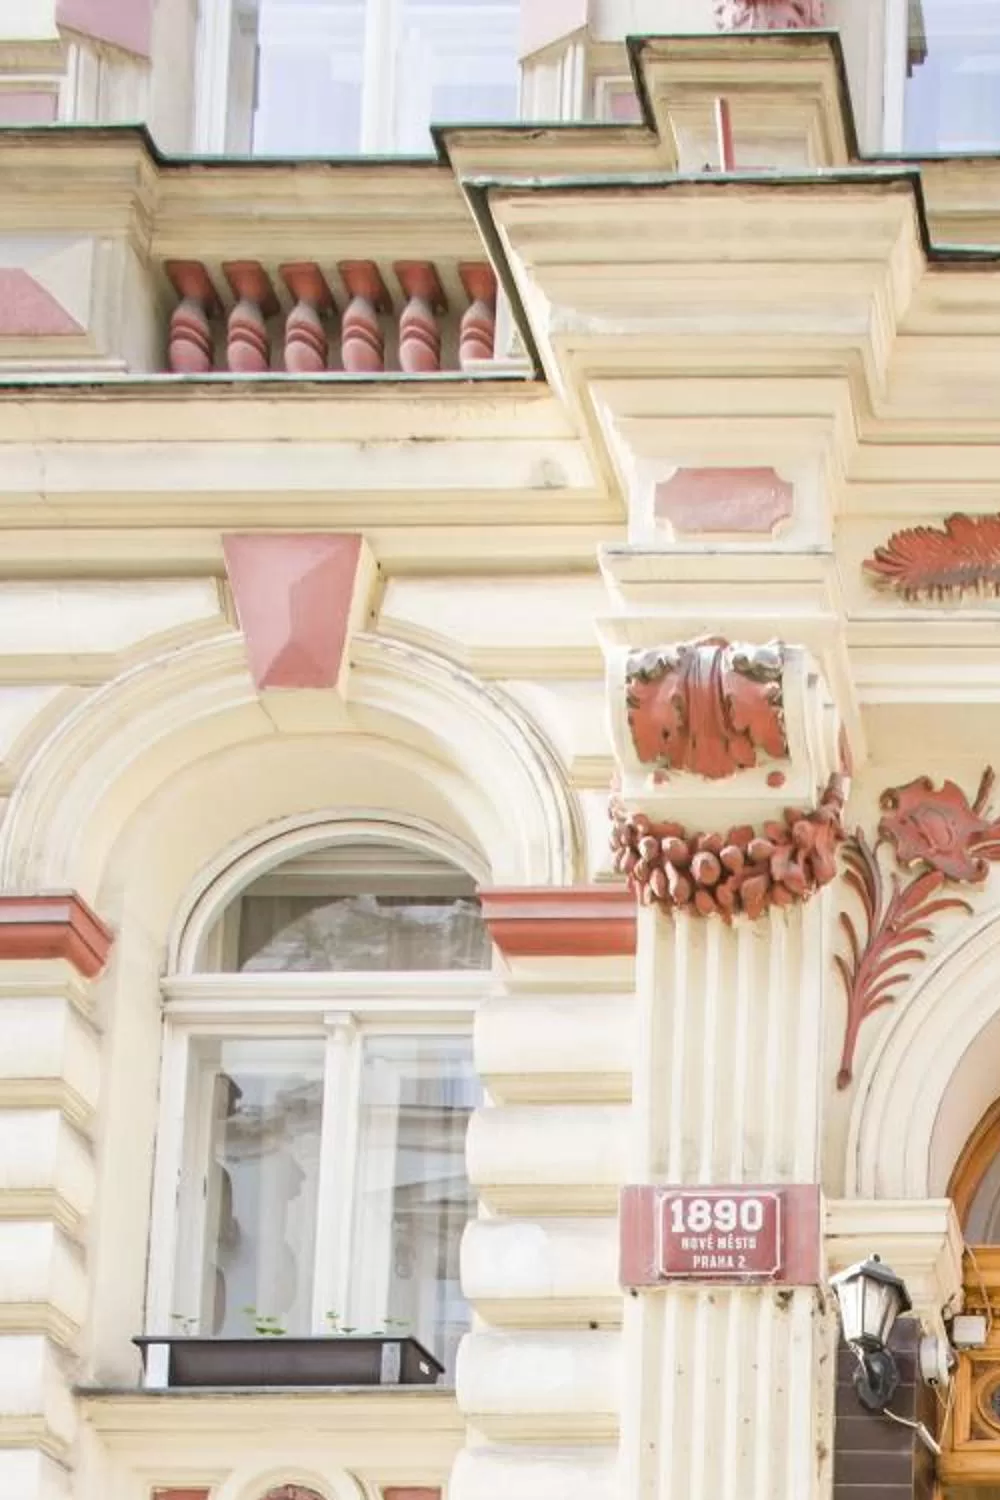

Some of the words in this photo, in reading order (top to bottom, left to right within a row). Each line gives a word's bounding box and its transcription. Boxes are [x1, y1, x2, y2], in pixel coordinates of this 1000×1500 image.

[671, 1199, 763, 1233] 1890
[681, 1233, 714, 1249] NOVÉ
[693, 1255, 733, 1269] PRAHA
[738, 1255, 746, 1269] 2
